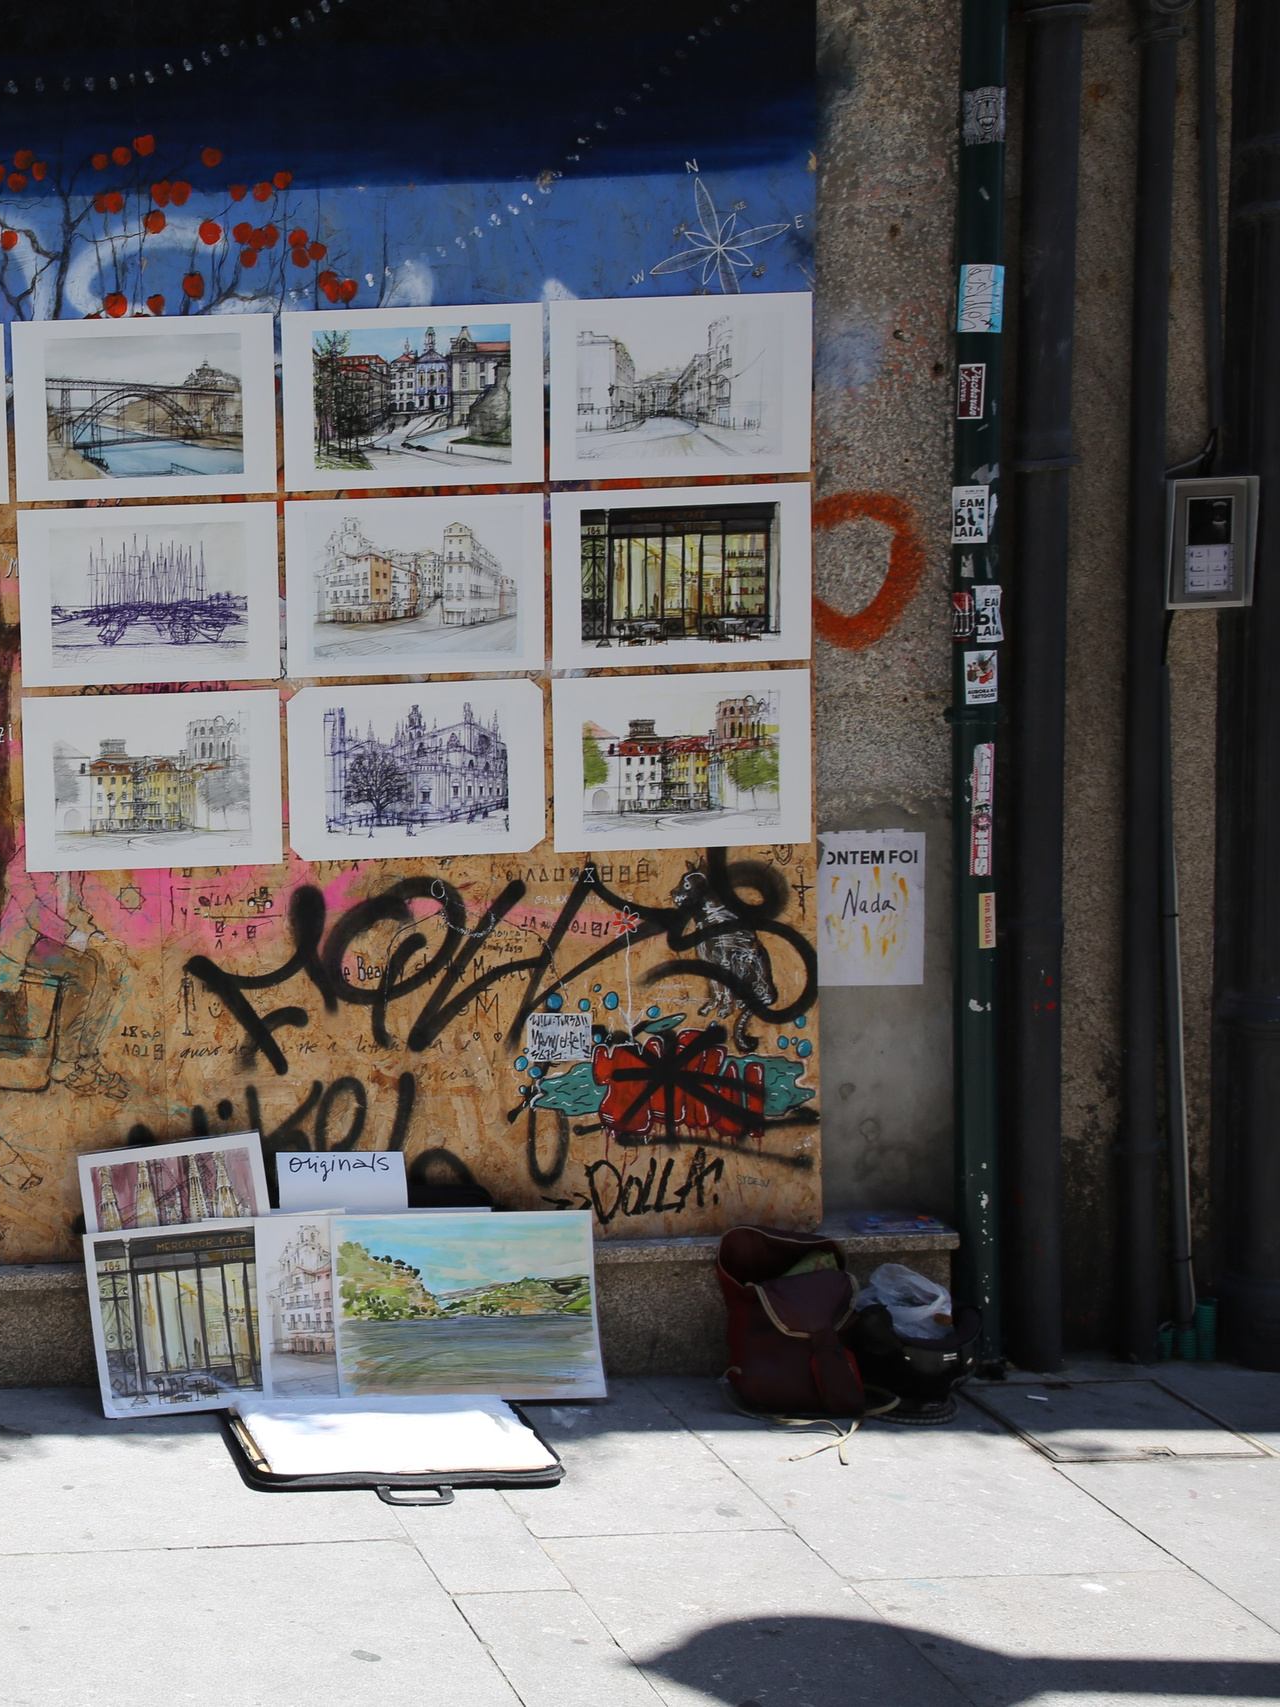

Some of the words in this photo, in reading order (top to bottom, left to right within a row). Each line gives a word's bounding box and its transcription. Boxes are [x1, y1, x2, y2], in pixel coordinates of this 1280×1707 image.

[685, 158, 700, 174] N
[794, 214, 805, 230] E
[631, 269, 646, 284] W
[954, 526, 984, 538] LAIA
[888, 849, 918, 864] FOI
[841, 880, 896, 920] Nada
[156, 1237, 214, 1252] MERCADOR
[103, 1260, 121, 1272] 184
